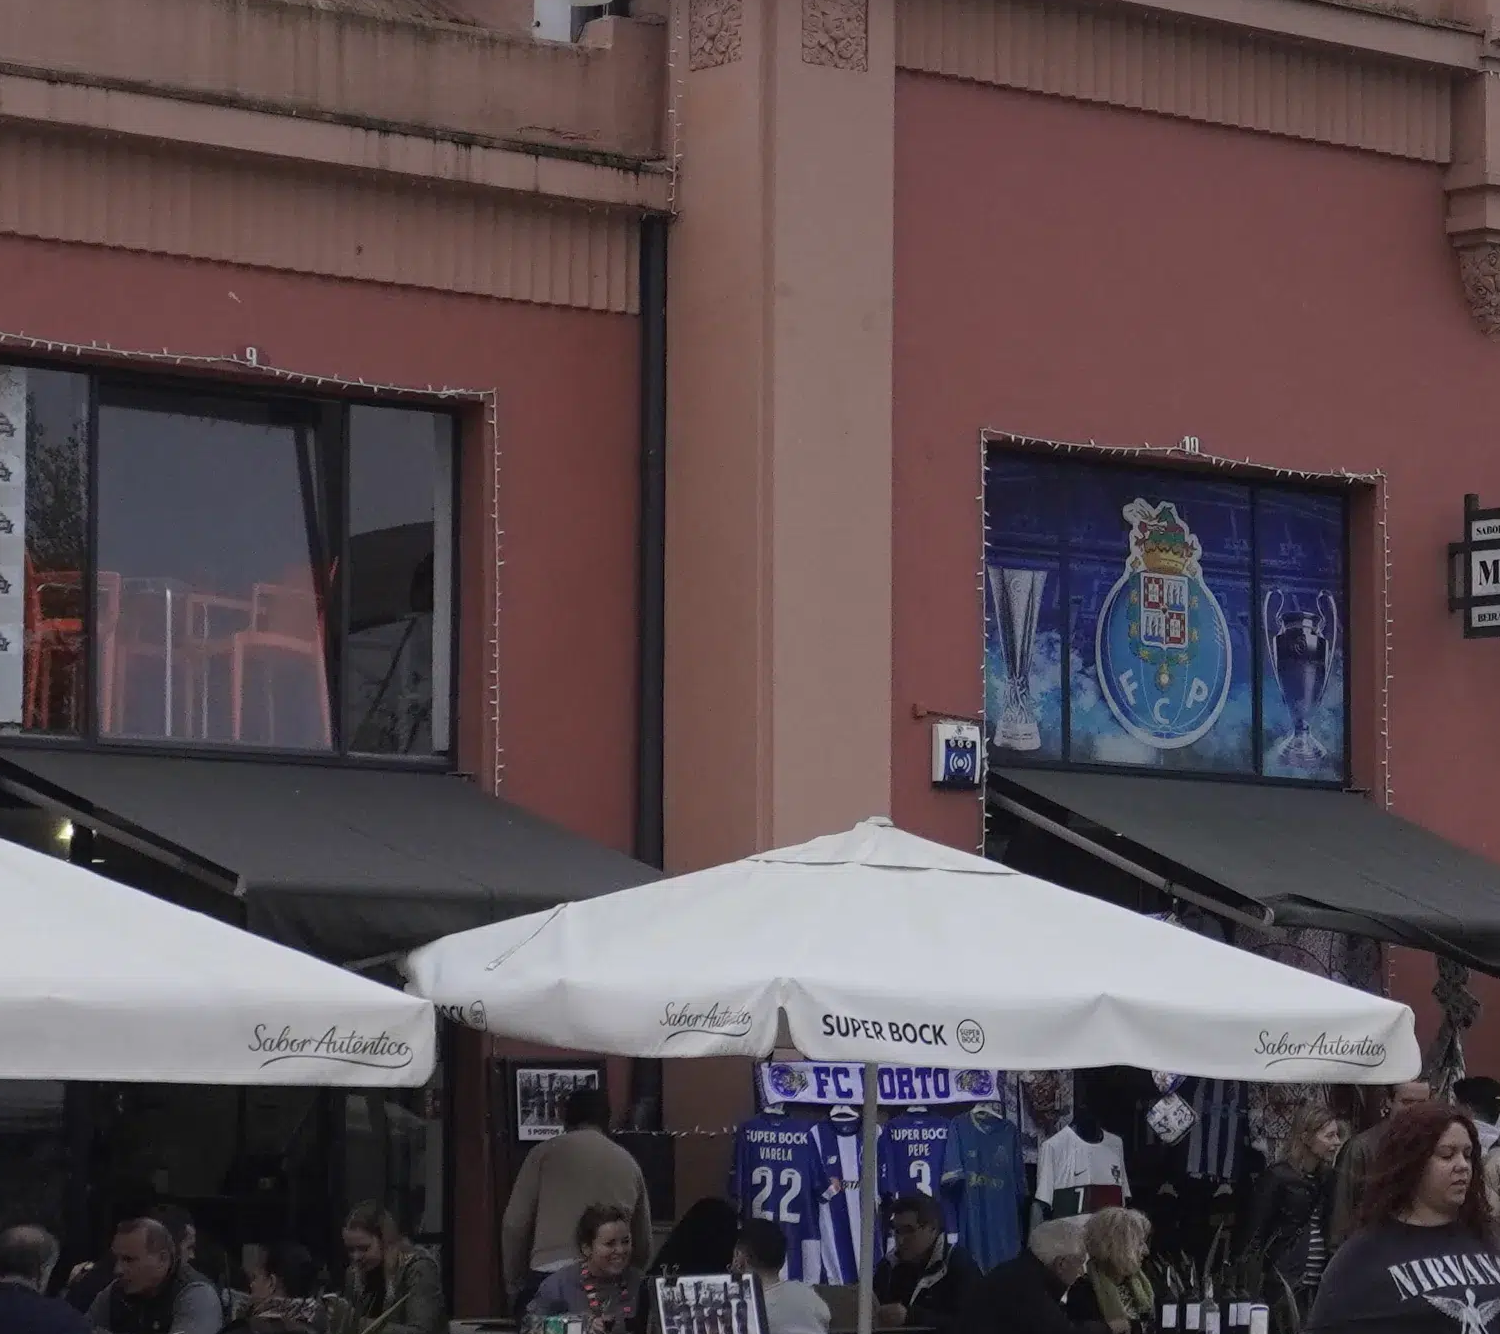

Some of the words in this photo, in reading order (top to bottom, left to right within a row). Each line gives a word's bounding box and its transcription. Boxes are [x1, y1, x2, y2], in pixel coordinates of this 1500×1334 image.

[245, 346, 258, 367] 9
[660, 1002, 701, 1028] Sabor
[248, 1023, 311, 1053] Sabor
[312, 1024, 413, 1057] Autêntico
[822, 1014, 888, 1042] SUPER
[889, 1021, 948, 1045] BOCK
[1254, 1030, 1306, 1056] Sabor
[1307, 1031, 1387, 1058] Autêntico
[813, 1067, 853, 1099] FC
[859, 1067, 951, 1101] ORTO
[778, 1131, 809, 1145] BOCK
[908, 1143, 931, 1157] PEPE
[759, 1146, 793, 1162] VARELA
[751, 1166, 801, 1224] 22
